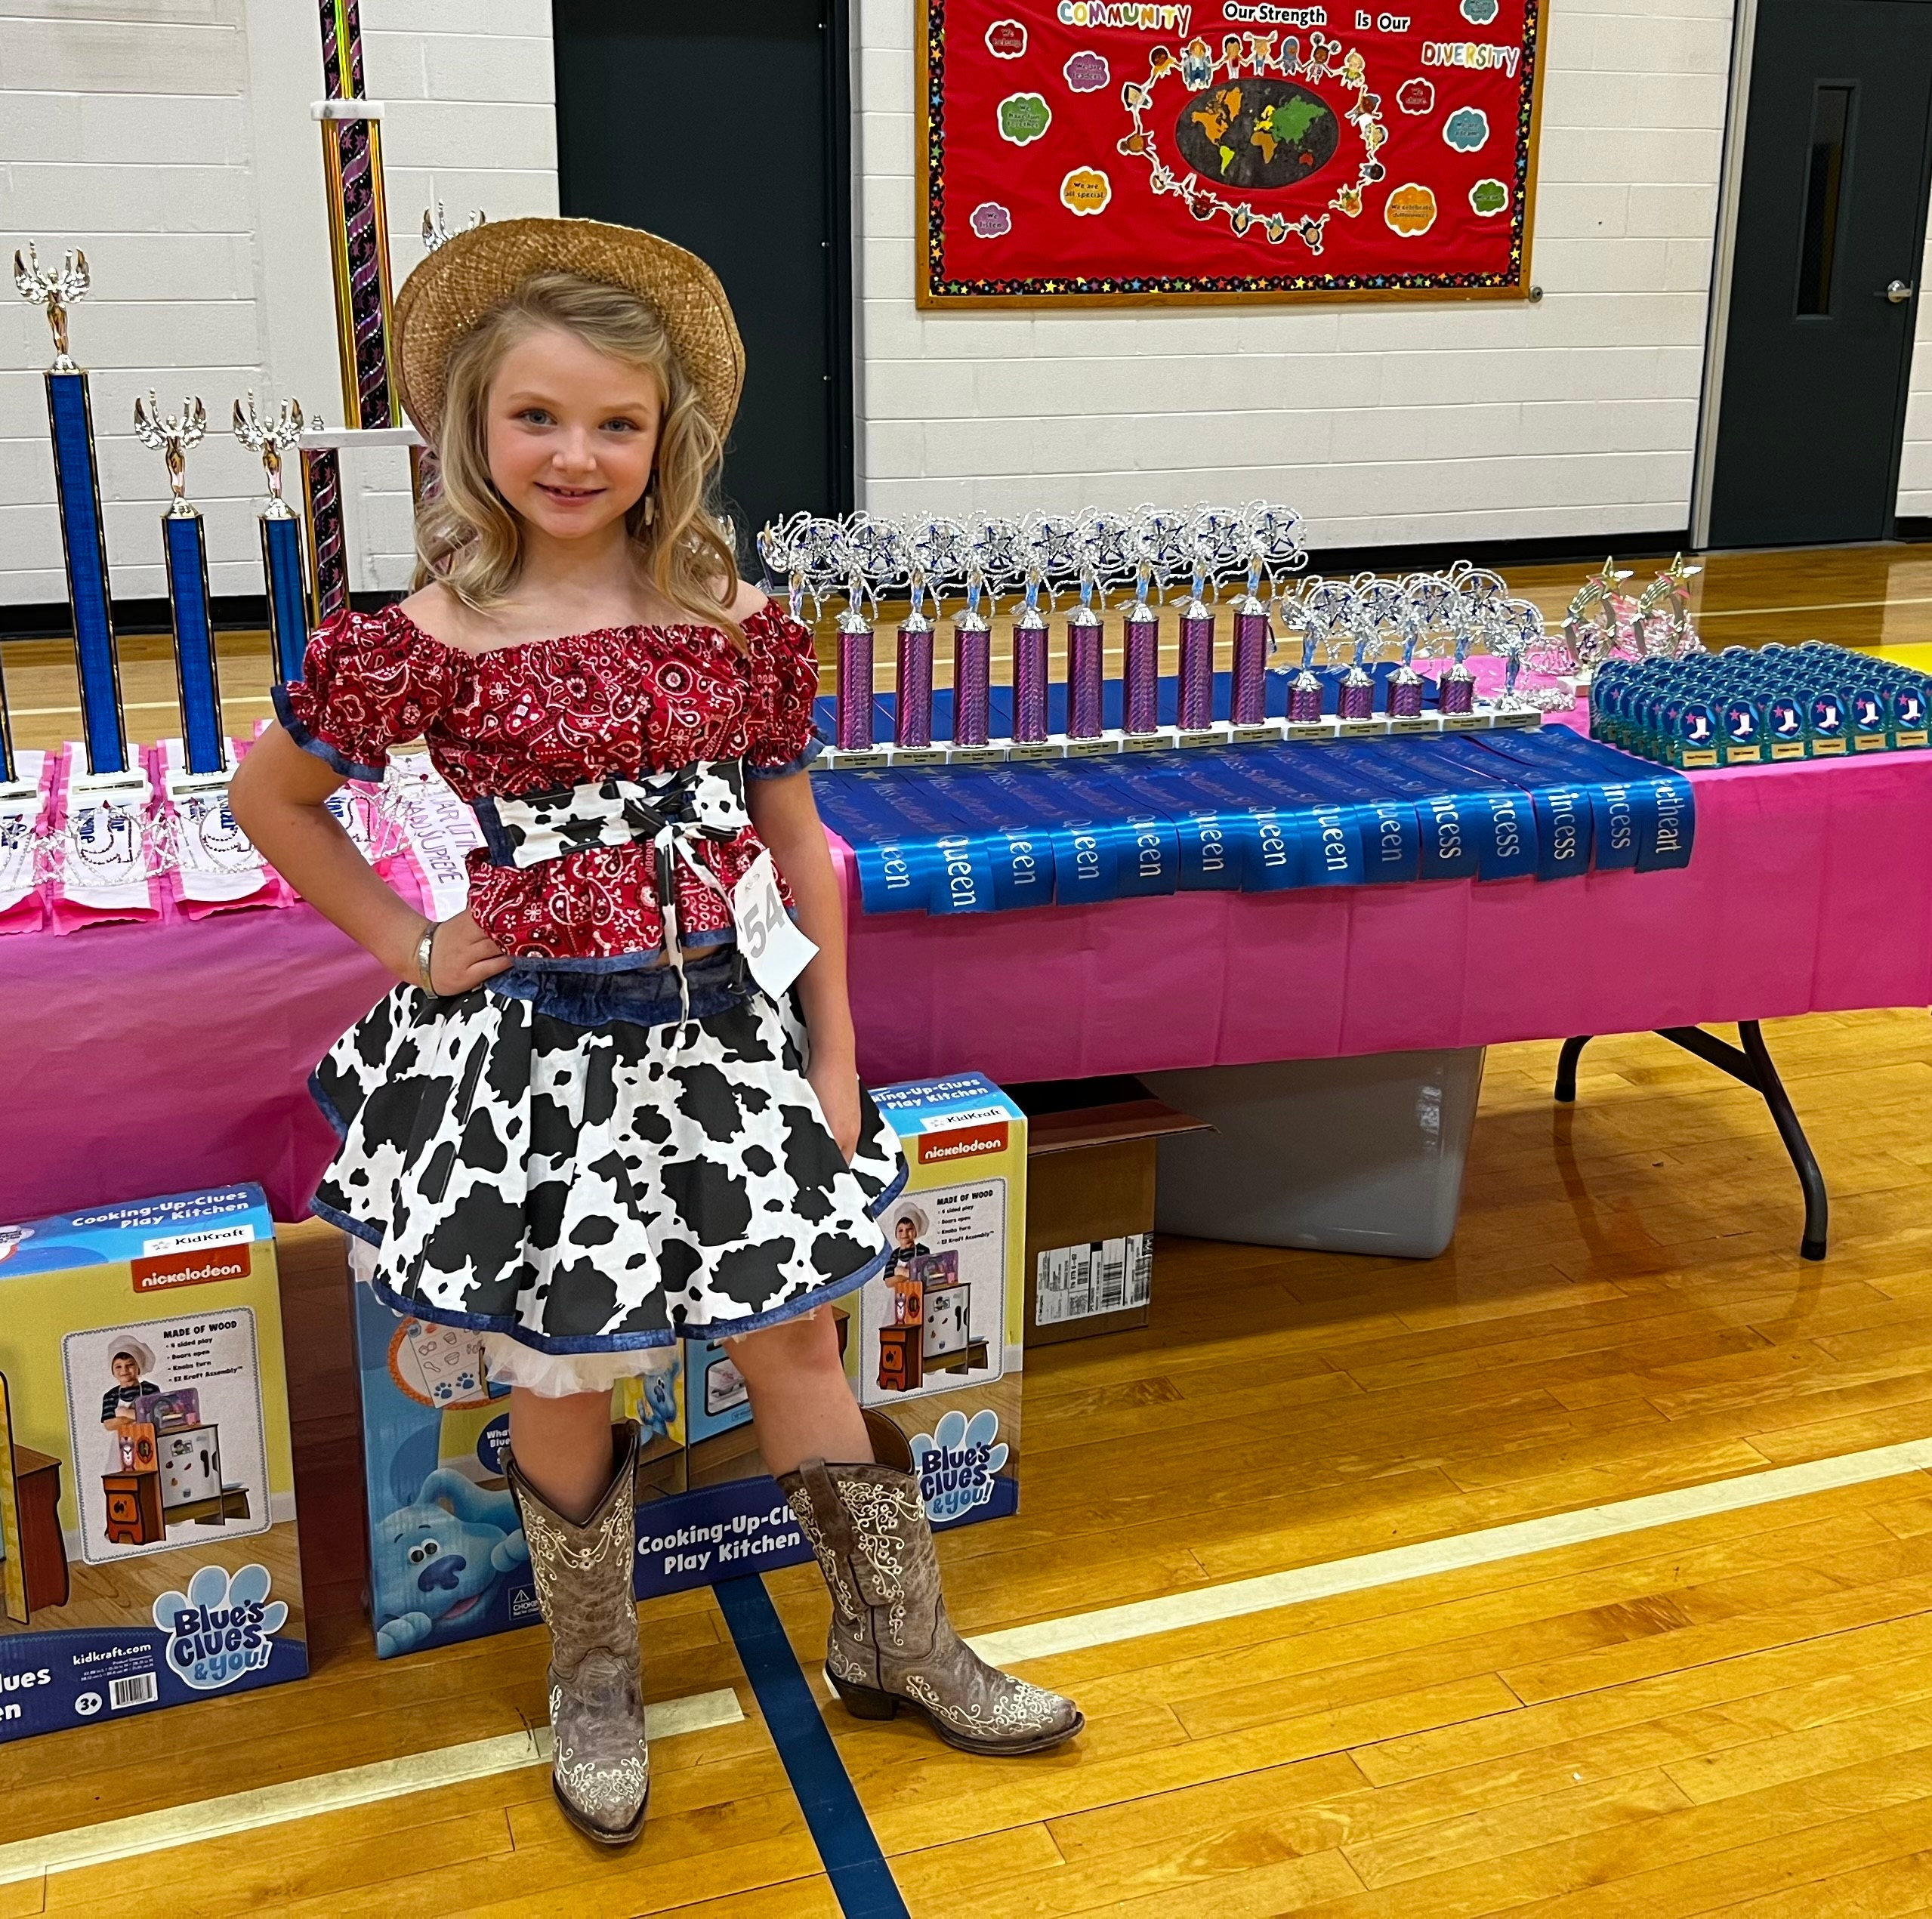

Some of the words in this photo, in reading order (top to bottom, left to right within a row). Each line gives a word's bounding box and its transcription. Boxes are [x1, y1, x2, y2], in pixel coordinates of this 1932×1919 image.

[1059, 1, 1190, 36] COMMUNITY
[1225, 3, 1255, 20] Our
[1259, 5, 1326, 26] Strength
[1357, 12, 1369, 27] Is
[1380, 15, 1409, 30] Our
[1424, 44, 1519, 76] DIVERSITY
[1063, 819, 1100, 880] Queen
[1126, 813, 1162, 878] Queen
[1188, 808, 1224, 872] Queen
[1248, 805, 1287, 867] Queen
[1312, 803, 1349, 871] Queen
[936, 835, 977, 907] Queen
[998, 823, 1036, 885] Queen
[742, 881, 785, 959] 54
[886, 1097, 921, 1110] Play
[925, 1087, 989, 1103] Kitchen
[946, 1109, 1001, 1124] KidKraft
[924, 1138, 1001, 1160] nickelodeon
[72, 1190, 248, 1227] Cooking-Up-Clues
[937, 1196, 958, 1205] MADE
[960, 1193, 969, 1202] OF
[971, 1189, 993, 1200] WOOD
[120, 1214, 164, 1229] Play
[171, 1201, 249, 1221] Kitchen
[174, 1229, 245, 1246] KidKraft
[141, 1262, 242, 1288] nickelodeon
[163, 1327, 190, 1339] MADE
[193, 1325, 206, 1334] OF
[208, 1320, 237, 1331] WOOD
[921, 1441, 992, 1476] Blue's
[919, 1463, 988, 1502] Clues
[665, 1550, 711, 1575] Play
[718, 1532, 801, 1563] Kitchen
[174, 1599, 265, 1638] Blue's
[73, 1644, 152, 1666] kidkraft.com
[174, 1624, 263, 1667] Clues
[80, 1698, 98, 1711] 3+
